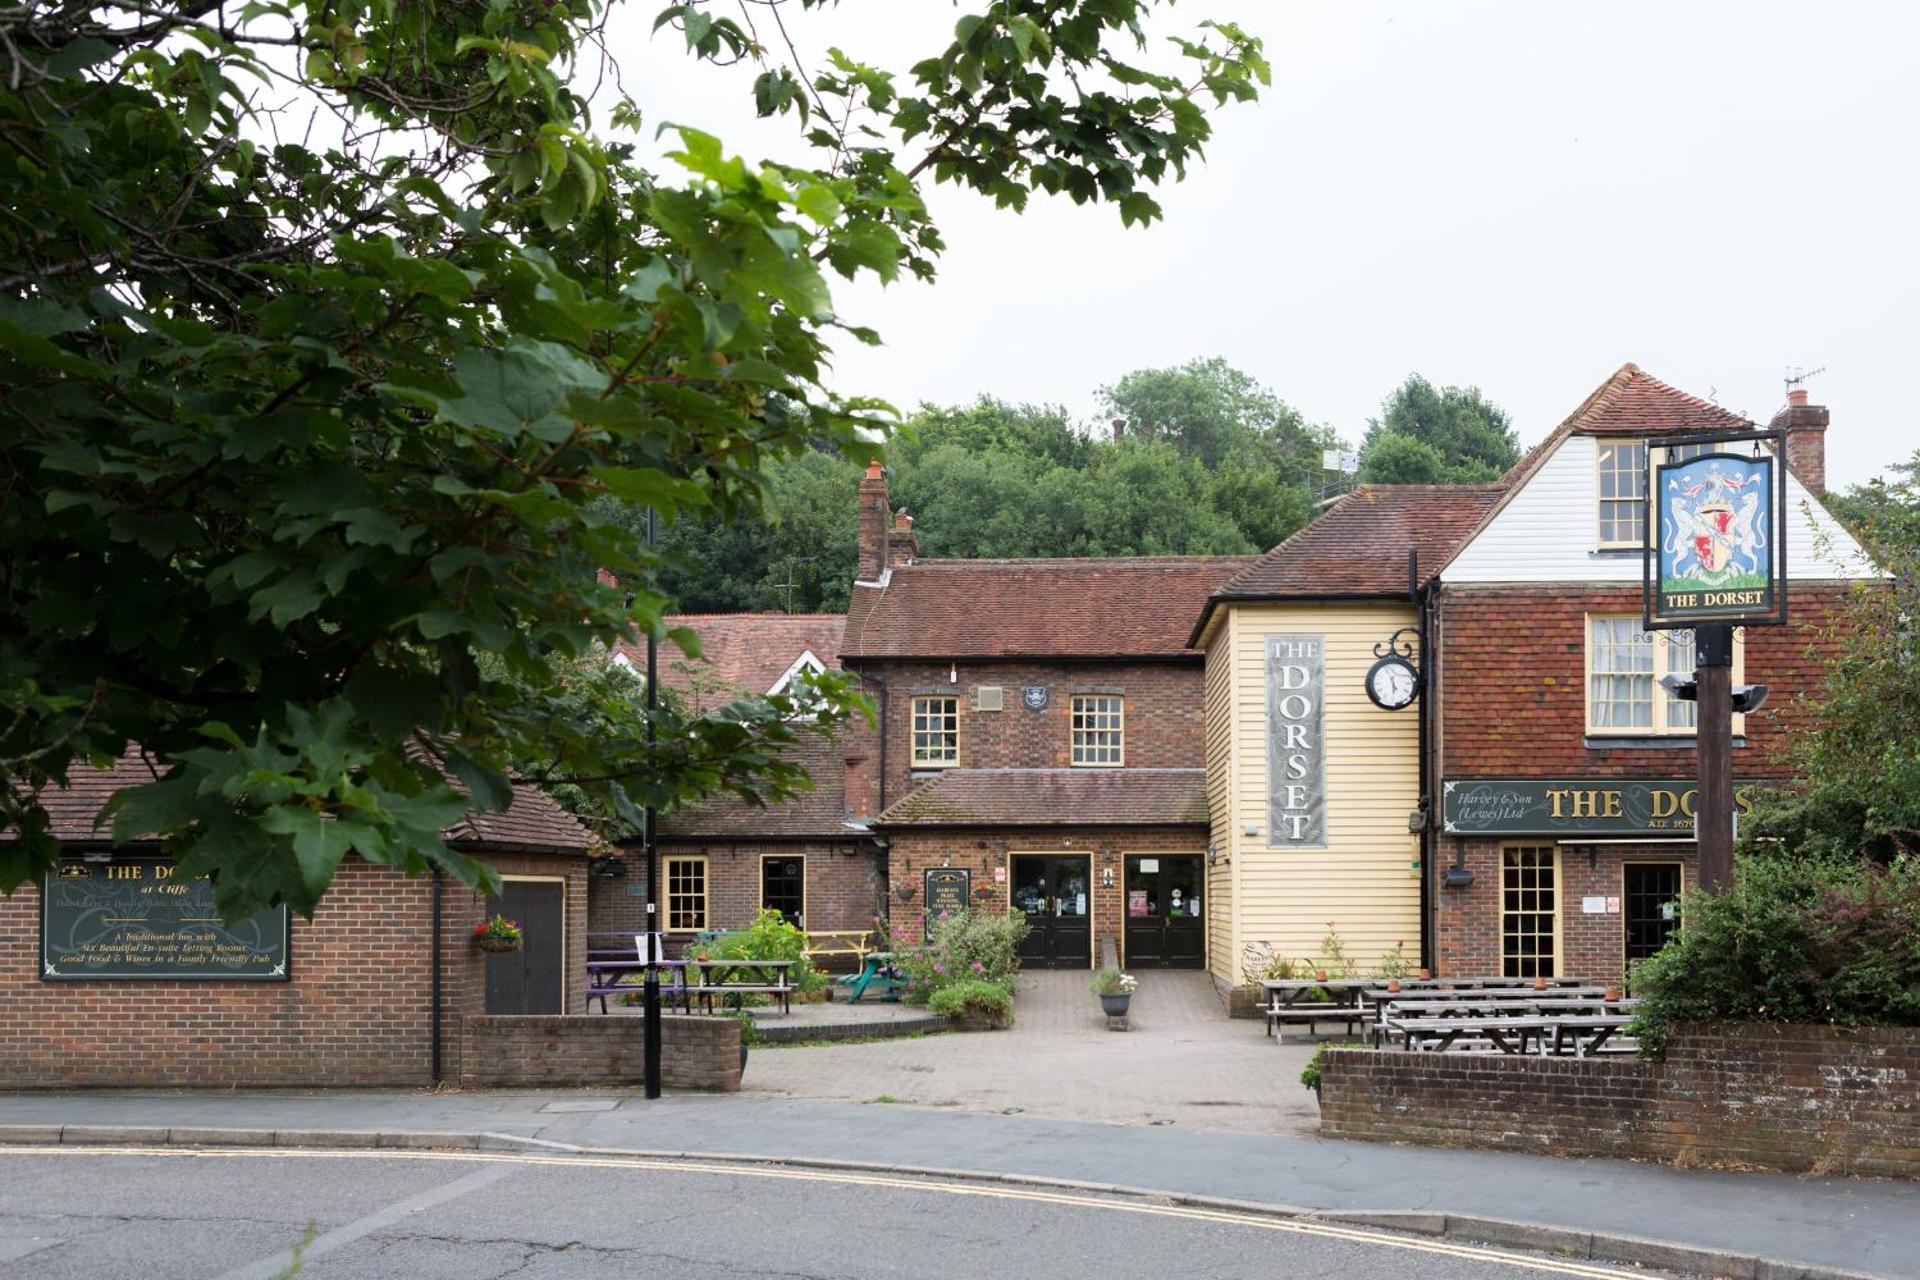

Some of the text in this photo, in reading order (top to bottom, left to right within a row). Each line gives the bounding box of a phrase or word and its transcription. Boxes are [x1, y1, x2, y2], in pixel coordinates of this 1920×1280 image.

[1666, 590, 1764, 608] THE DORSET
[1271, 641, 1319, 658] THE
[1279, 665, 1312, 840] DORSET
[1458, 793, 1497, 808] Harvey
[1512, 793, 1532, 804] Son
[1546, 789, 1622, 818] THE
[1503, 807, 1524, 819] Ltd
[105, 866, 142, 880] THE
[196, 931, 217, 941] with
[81, 944, 96, 952] Six
[99, 944, 139, 953] Beautiful
[182, 944, 213, 954] Letting
[216, 944, 247, 952] Rooms
[60, 955, 85, 963] Good
[88, 954, 111, 963] Food
[125, 954, 151, 963] Wines
[178, 954, 207, 964] Family
[211, 954, 248, 964] Friendly
[252, 954, 271, 963] Pub
